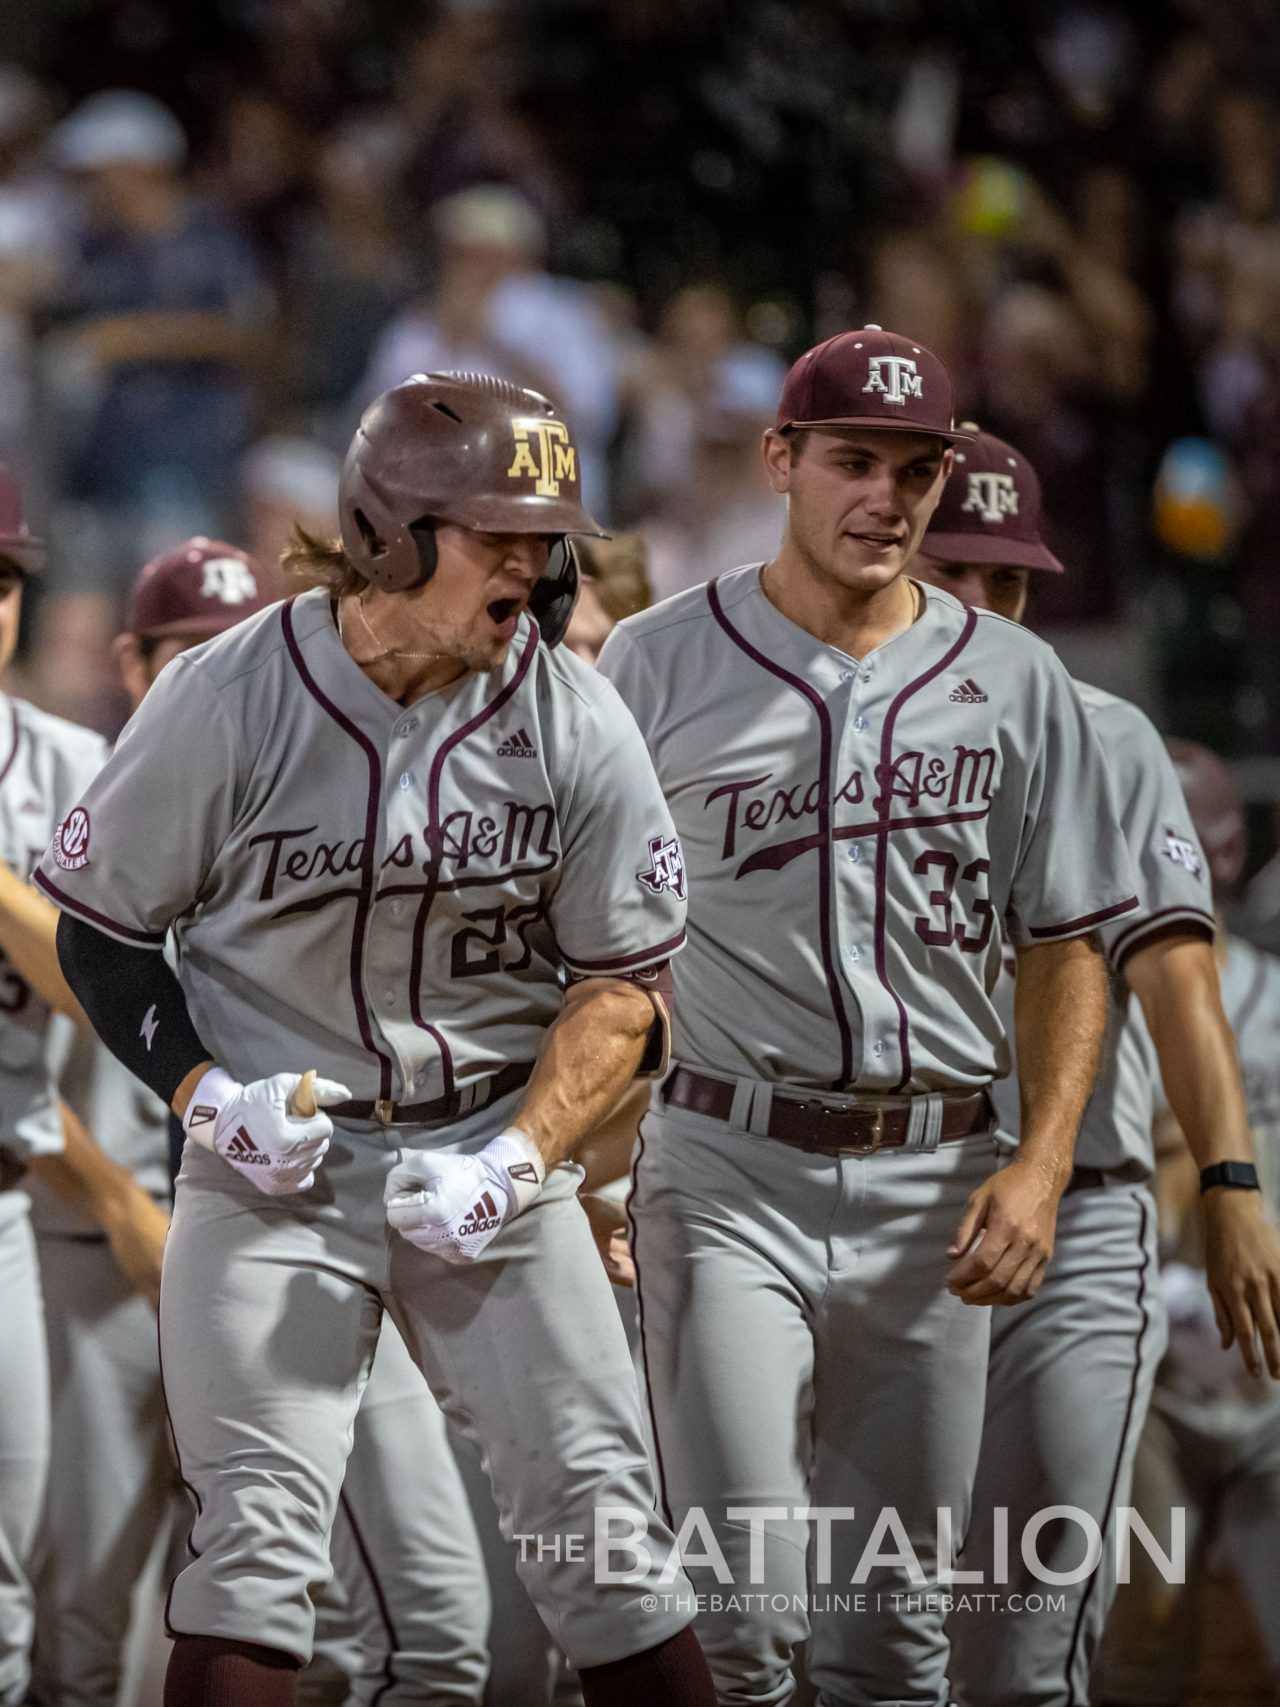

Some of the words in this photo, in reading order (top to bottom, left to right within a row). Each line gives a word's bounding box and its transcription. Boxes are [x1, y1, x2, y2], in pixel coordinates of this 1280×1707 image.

[948, 693, 989, 704] adidas
[496, 746, 538, 759] adidas
[63, 810, 87, 855] SEC
[704, 773, 864, 860] Texas
[250, 824, 413, 900] Texas
[913, 849, 994, 954] 33
[458, 1217, 501, 1236] adidas
